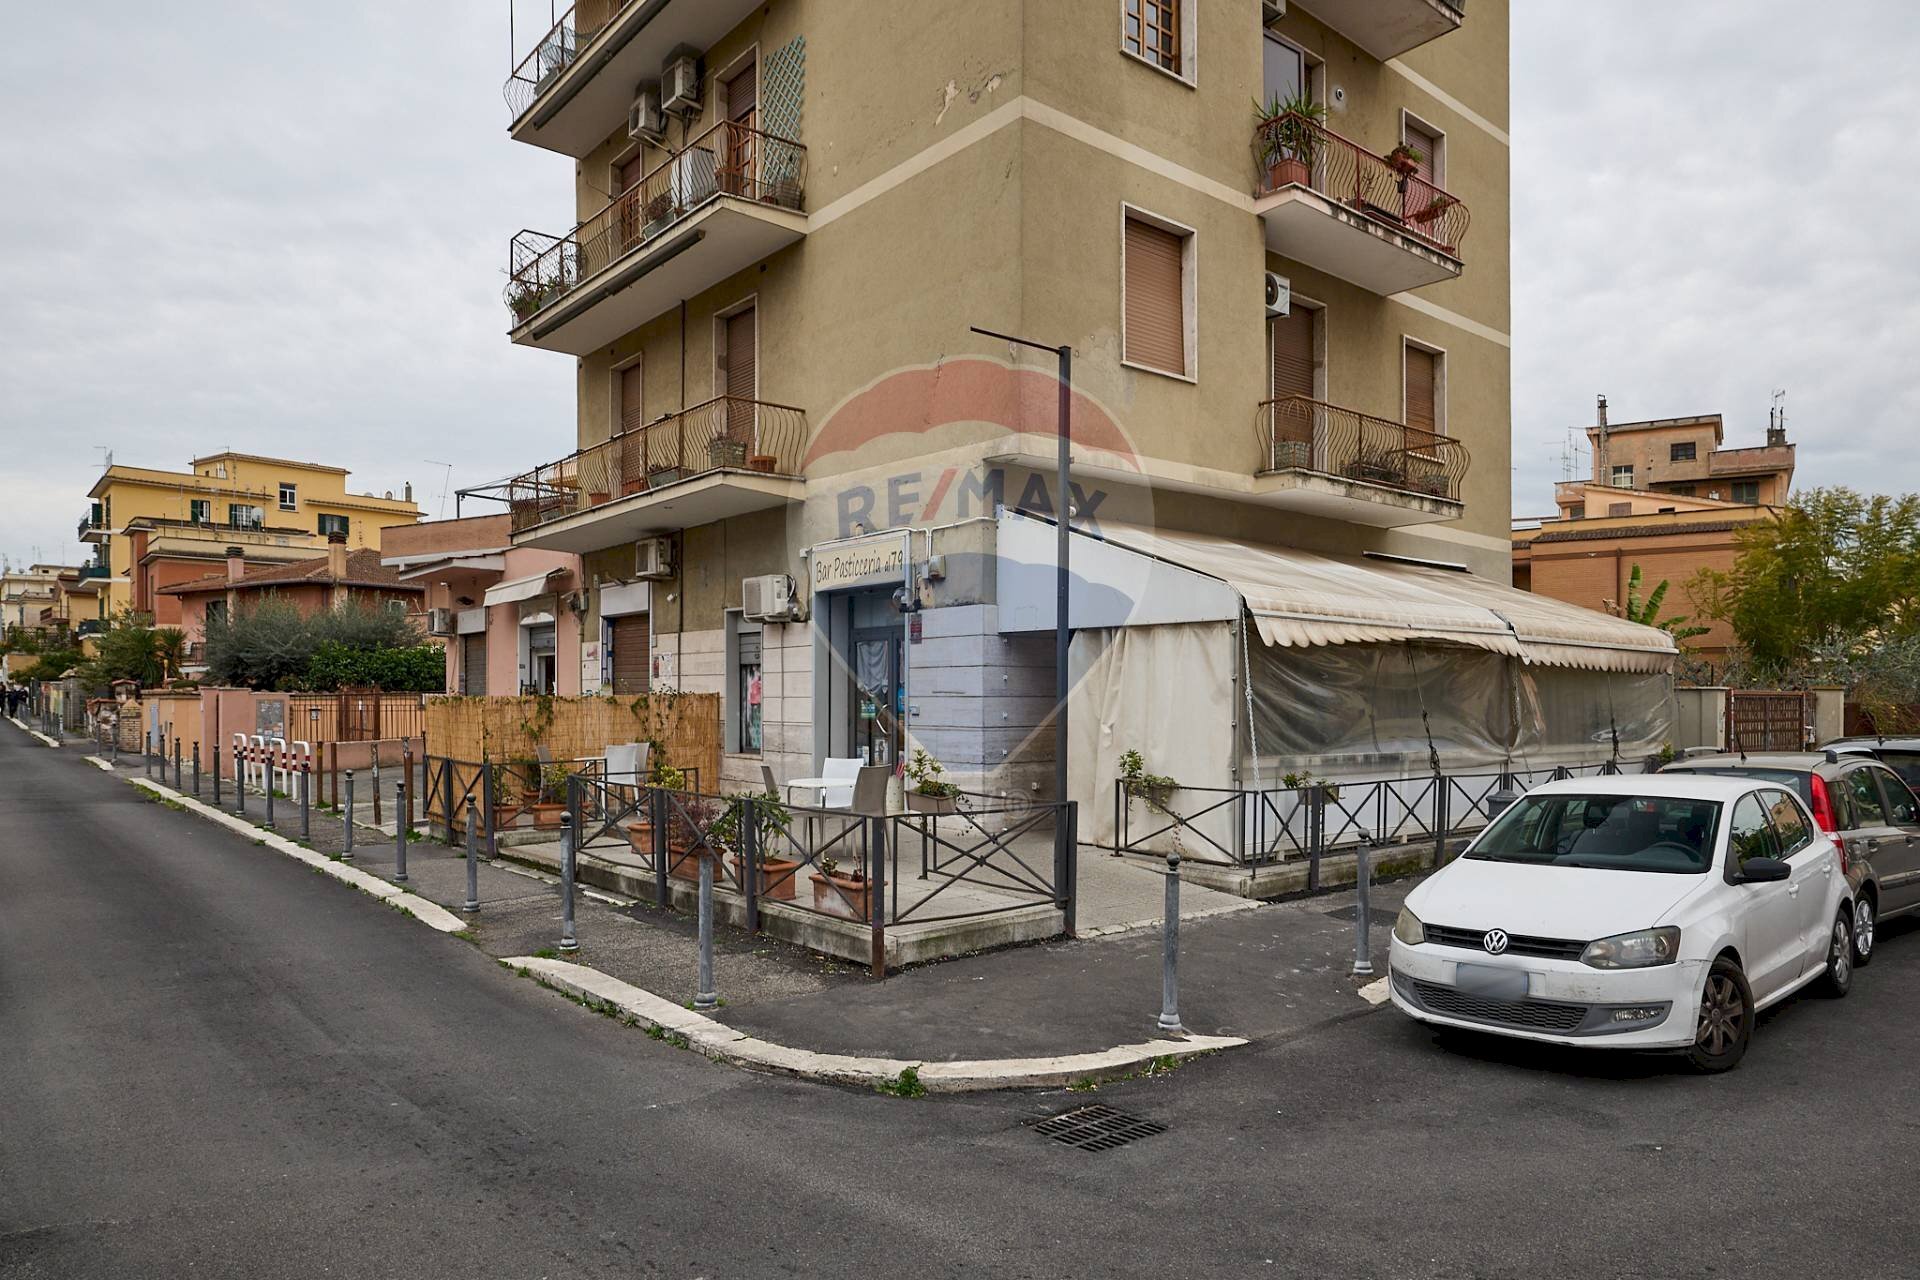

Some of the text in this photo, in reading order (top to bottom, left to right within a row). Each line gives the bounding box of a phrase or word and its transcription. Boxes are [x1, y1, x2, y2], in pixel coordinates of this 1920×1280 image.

[816, 561, 832, 583] Bar
[834, 550, 881, 579] Pasticceria
[1484, 929, 1508, 954] VW
